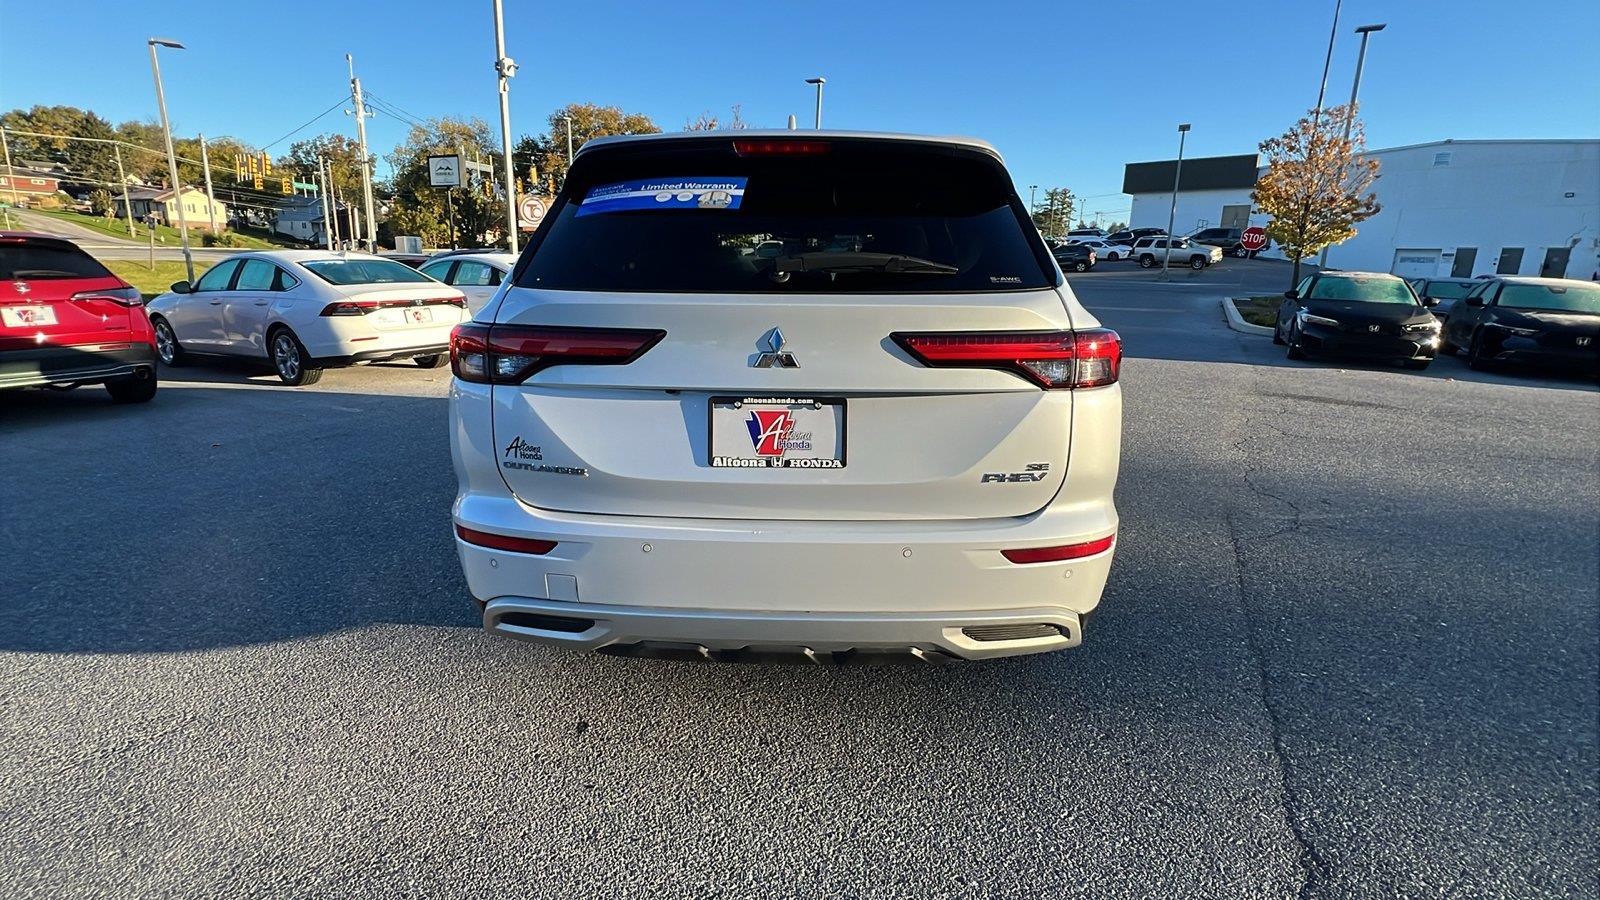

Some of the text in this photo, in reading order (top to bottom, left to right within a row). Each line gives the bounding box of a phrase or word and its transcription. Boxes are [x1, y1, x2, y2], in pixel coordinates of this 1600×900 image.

[641, 182, 738, 191] Limited Warranty
[1242, 232, 1266, 243] STOP
[743, 397, 814, 405] altoonahonda.com
[778, 440, 811, 450] Honda
[520, 452, 543, 460] Honda
[712, 456, 767, 468] Altoona
[789, 458, 843, 468] HONDA
[1025, 463, 1050, 472] SE
[981, 472, 1048, 483] PHEV
